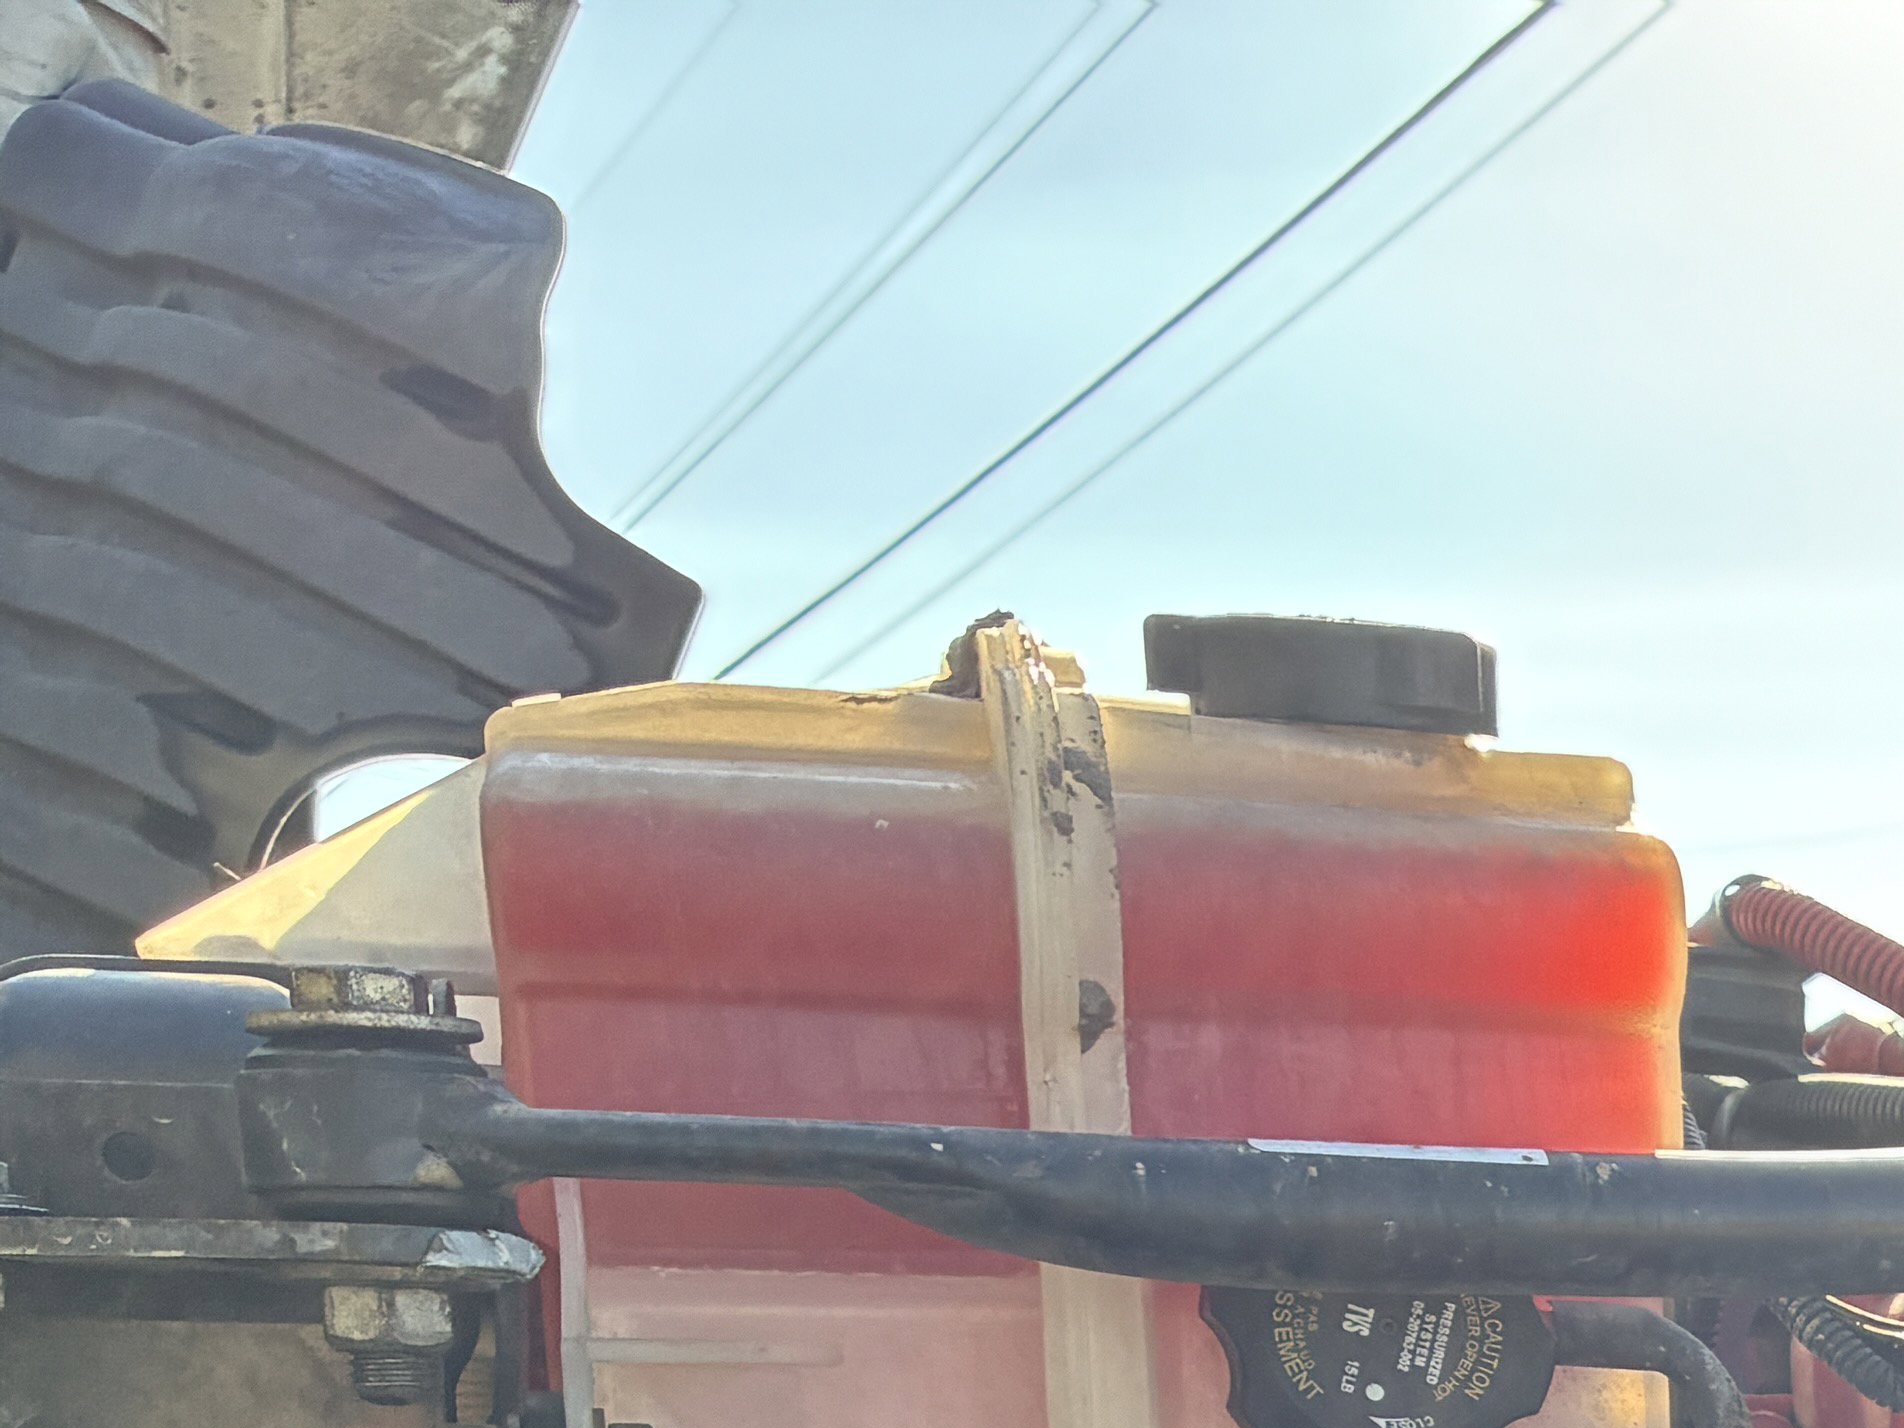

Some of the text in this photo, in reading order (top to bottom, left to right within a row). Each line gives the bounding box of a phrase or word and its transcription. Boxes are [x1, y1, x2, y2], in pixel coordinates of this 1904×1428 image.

[1272, 1289, 1325, 1401] SSEMENT
[1341, 1302, 1376, 1337] TVS
[1414, 1313, 1437, 1368] SYSTEM
[1426, 1302, 1456, 1385] PRESSURIZED
[1433, 1294, 1480, 1402] EVER OPEN HOT
[1464, 1318, 1503, 1401] CAUTION
